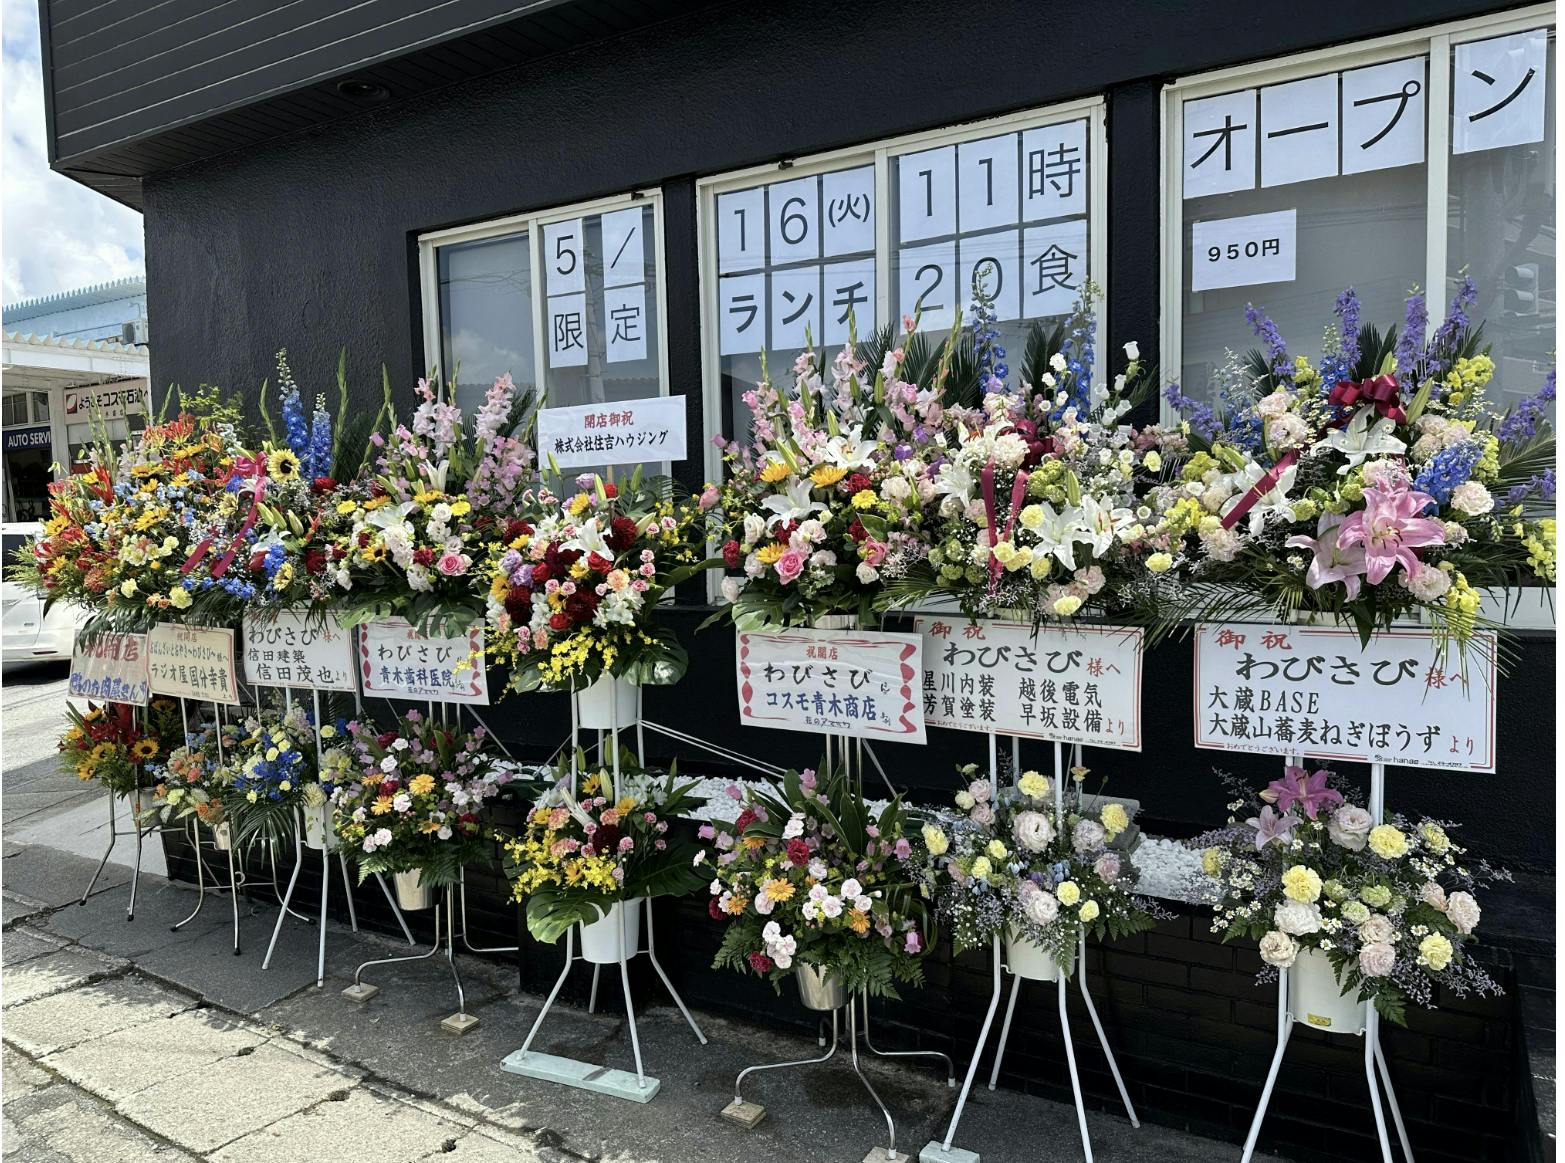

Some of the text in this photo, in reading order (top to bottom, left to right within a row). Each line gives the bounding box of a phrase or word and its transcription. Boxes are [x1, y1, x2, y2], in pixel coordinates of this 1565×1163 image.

[1191, 66, 1536, 171] オープン
[918, 142, 1082, 217] 11時
[1207, 237, 1281, 263] 950円
[728, 243, 1079, 334] ランチ 20食
[553, 303, 641, 352] 限定
[584, 410, 634, 429] 開店御祝
[8, 433, 30, 448] AUTO
[554, 429, 669, 454] 株式会社住吉ハウジング
[248, 625, 317, 646] わびさび
[928, 621, 986, 641] 御祝
[1214, 630, 1292, 651] 御祝
[247, 647, 307, 664] 信田建築
[378, 643, 453, 663] わびさび
[805, 645, 839, 661] 祝開店
[943, 641, 1122, 678] わびさび 様へ
[255, 662, 335, 684] 信田茂也
[379, 665, 455, 689] 青木歯科医院
[763, 661, 873, 690] わびさび
[1235, 652, 1419, 686] わびさび
[923, 670, 995, 699] 星川内装
[1018, 677, 1102, 709] 越後電気
[766, 690, 877, 721] コスモ青木商店
[923, 693, 996, 722] 芳賀塗装
[1019, 702, 1103, 734] 早坂設備
[1208, 712, 1441, 754] 大蔵山蕎麦ねぎぼうず
